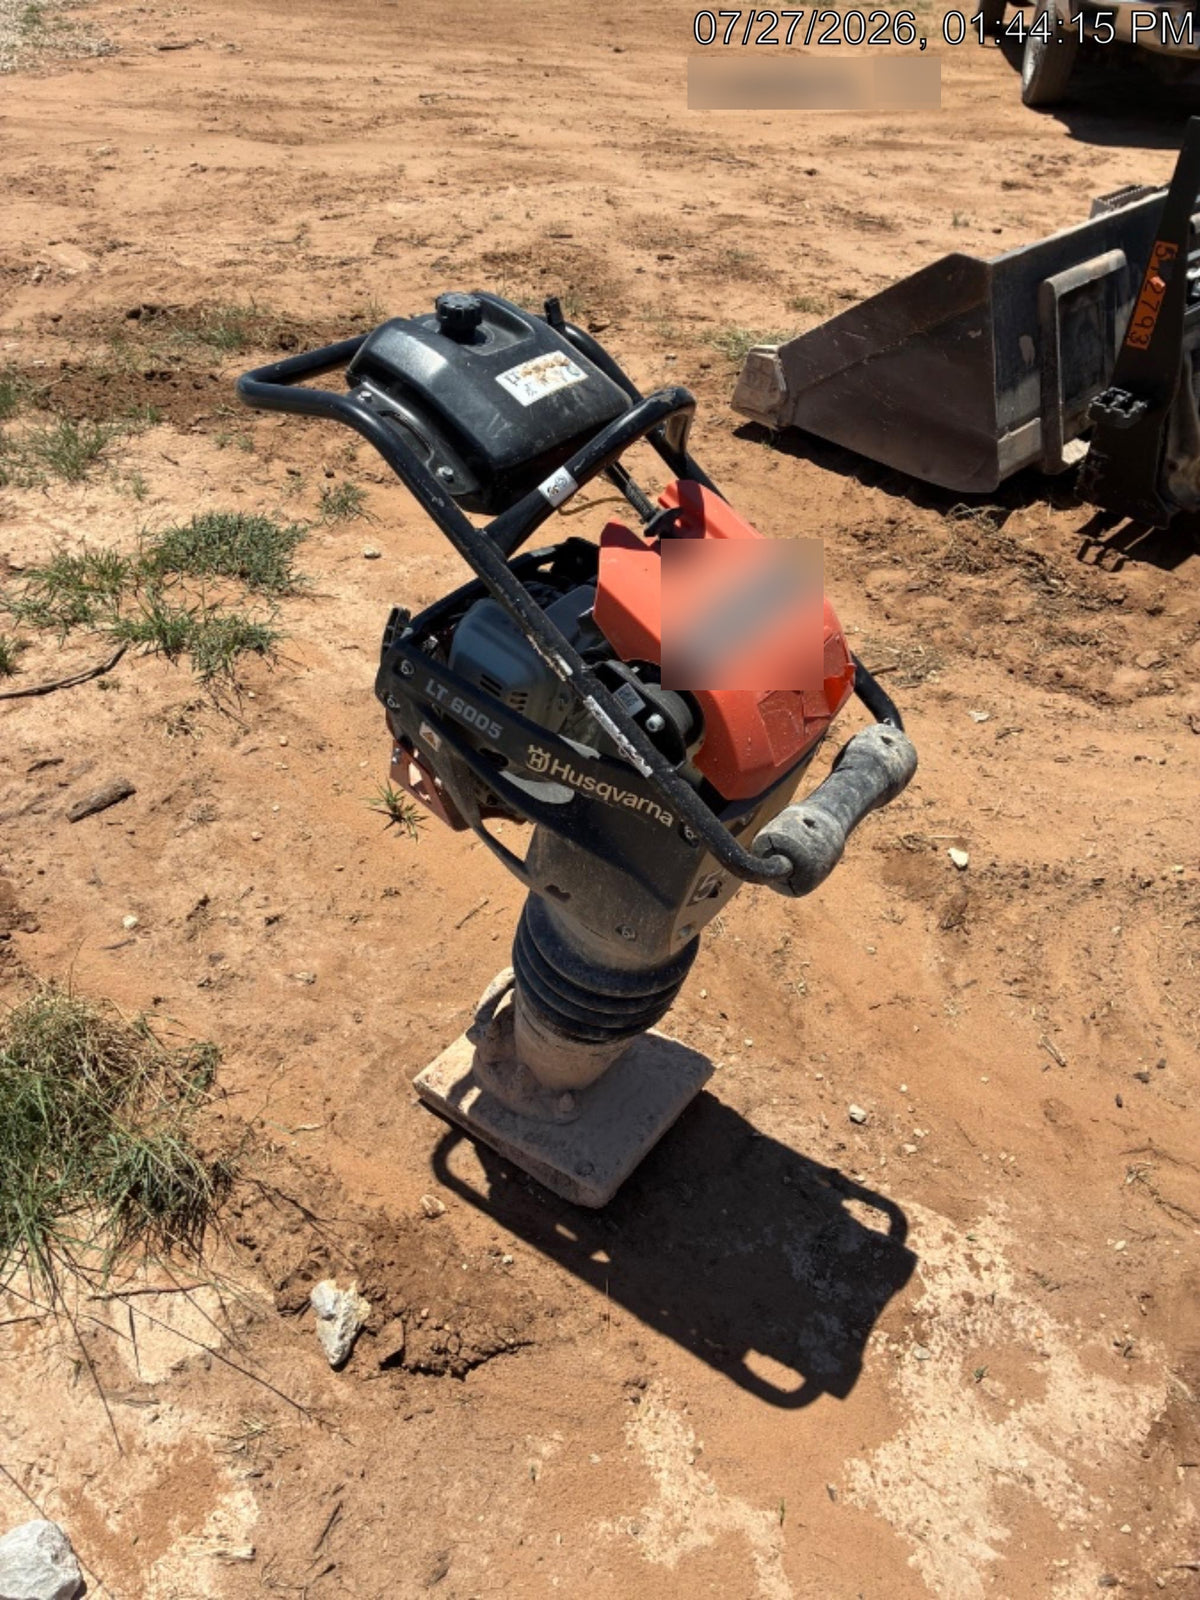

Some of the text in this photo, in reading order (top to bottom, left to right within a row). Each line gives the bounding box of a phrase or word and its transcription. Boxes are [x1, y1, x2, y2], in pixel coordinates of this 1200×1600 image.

[426, 679, 503, 739] LT 6005
[550, 758, 674, 827] Husqvarna
